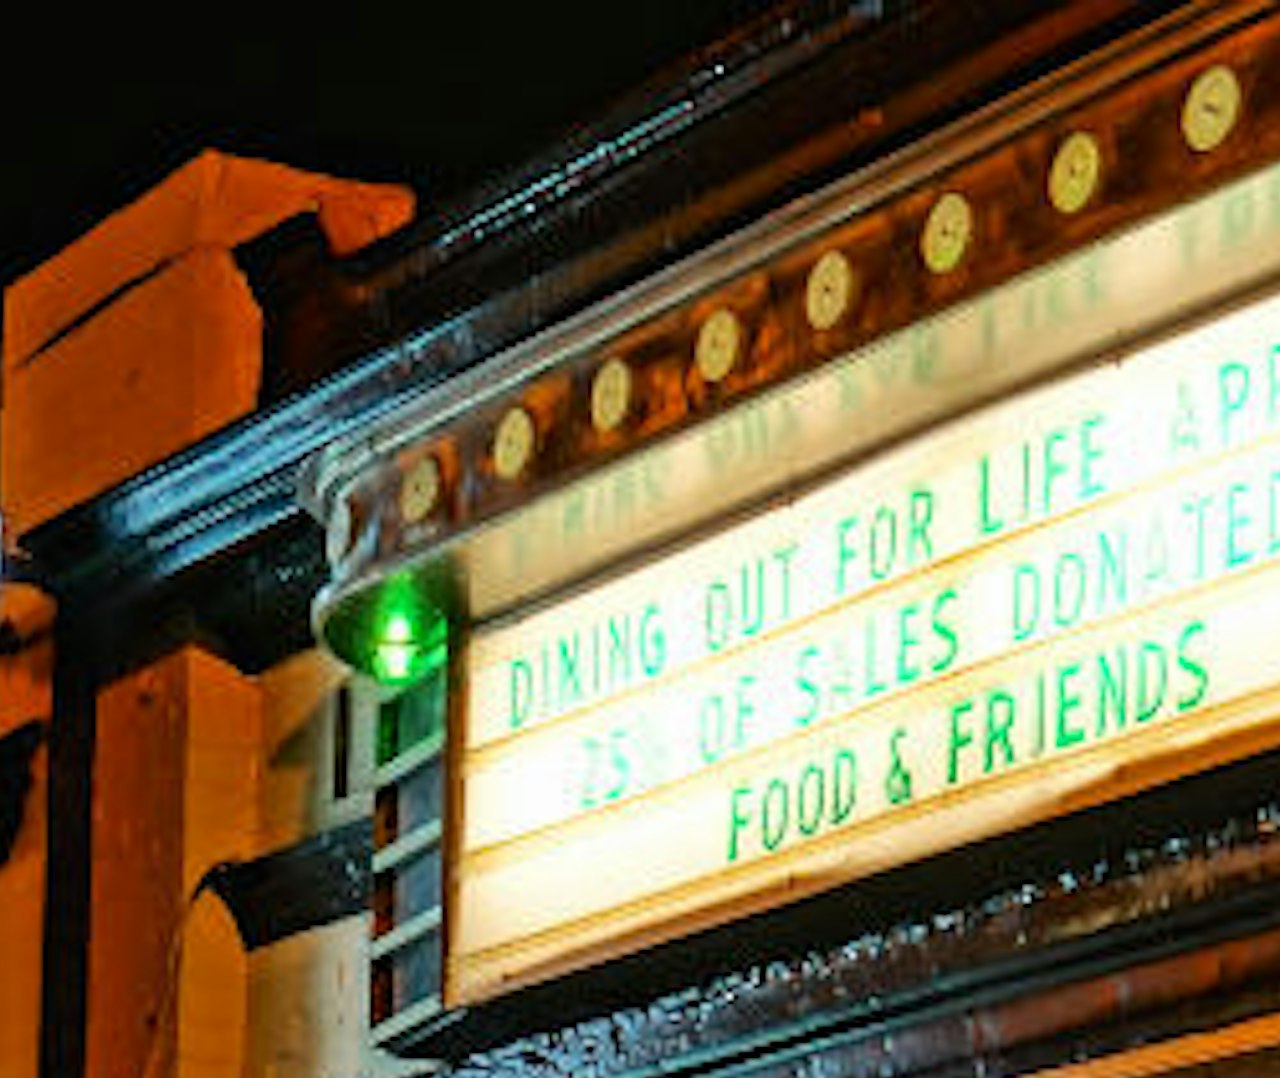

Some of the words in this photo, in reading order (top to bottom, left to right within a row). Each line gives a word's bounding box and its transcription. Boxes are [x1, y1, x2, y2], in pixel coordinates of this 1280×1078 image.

[706, 543, 798, 653] OUT
[836, 489, 935, 593] FOR
[980, 414, 1108, 536] LIFE
[700, 675, 758, 766] OF
[728, 748, 858, 862] FOOD
[884, 726, 914, 806] &
[946, 620, 1210, 785] FRIENDS
